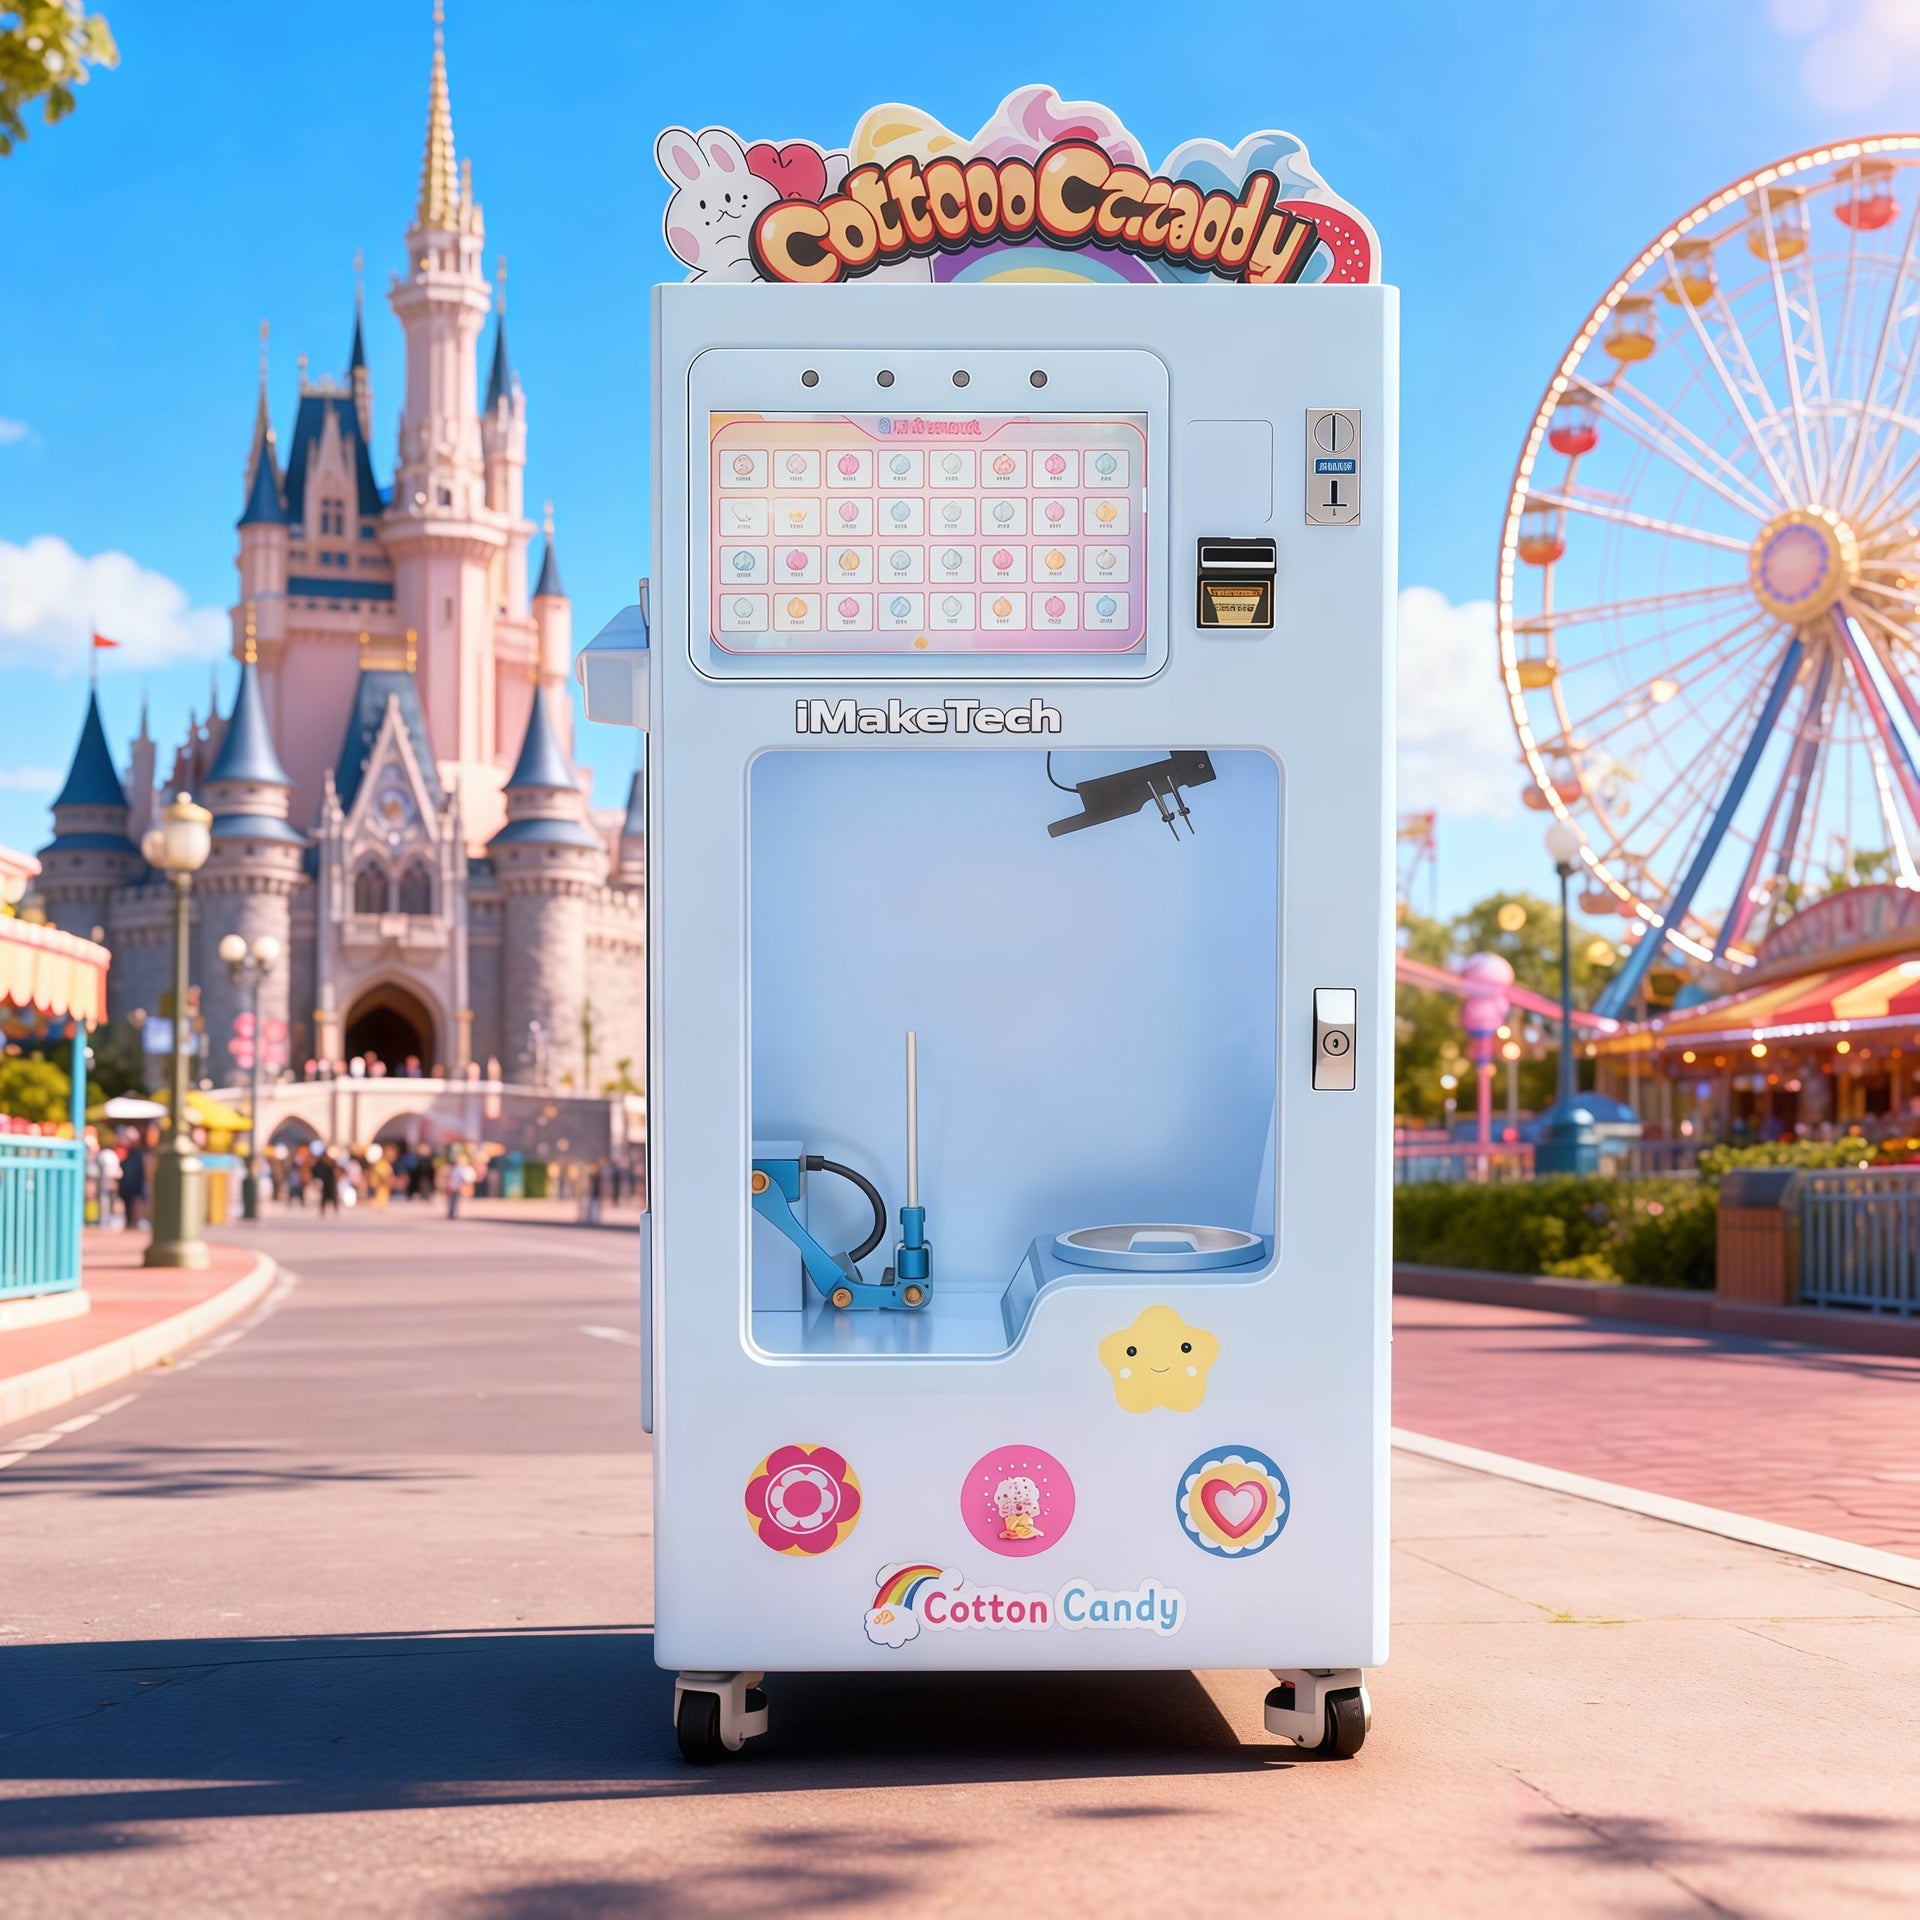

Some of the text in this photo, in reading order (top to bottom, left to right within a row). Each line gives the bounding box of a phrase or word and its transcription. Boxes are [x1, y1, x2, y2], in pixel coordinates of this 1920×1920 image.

[795, 698, 1062, 734] iMakeTech
[924, 1588, 1178, 1629] Cotton Candy
